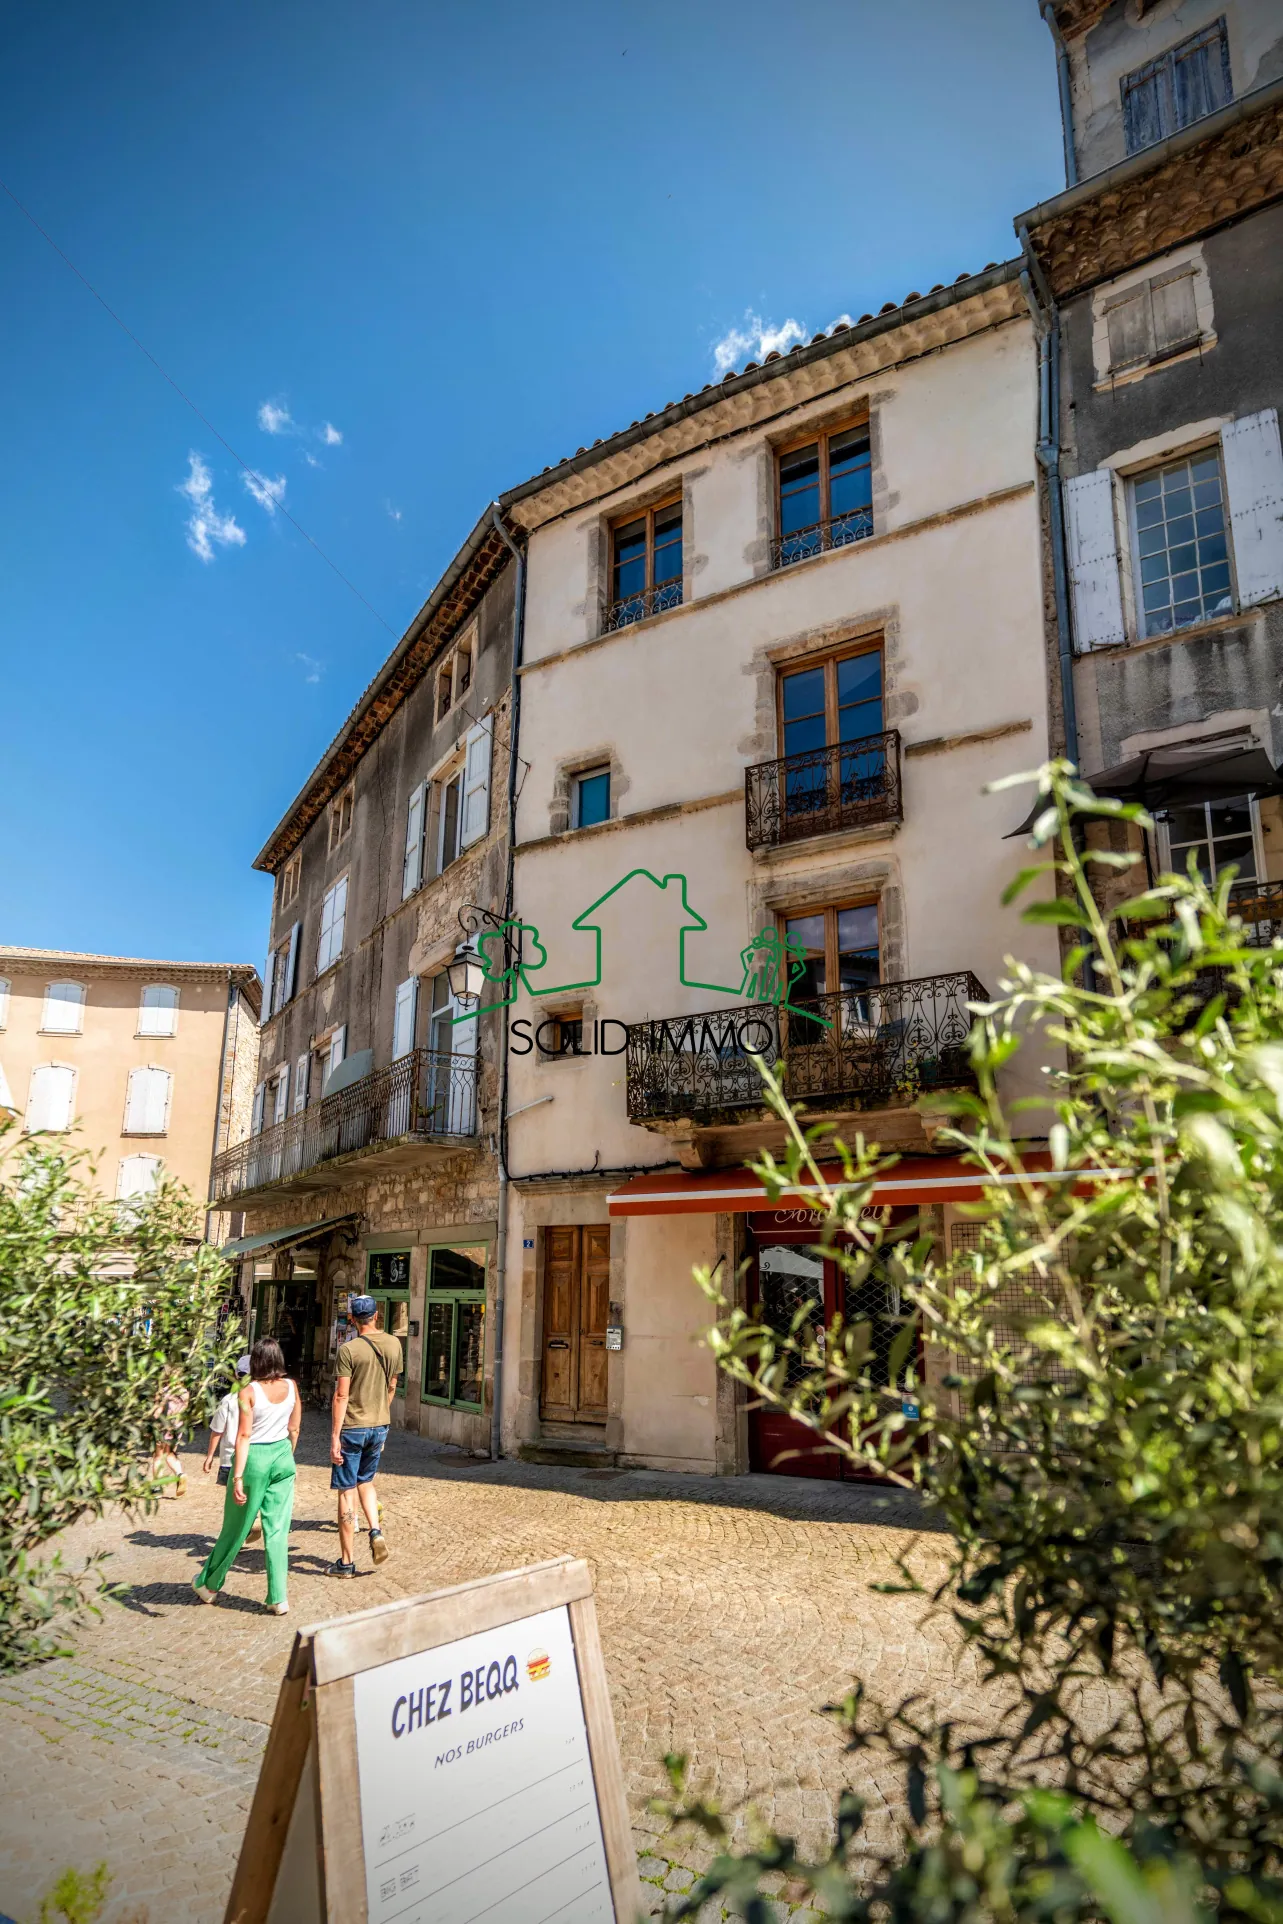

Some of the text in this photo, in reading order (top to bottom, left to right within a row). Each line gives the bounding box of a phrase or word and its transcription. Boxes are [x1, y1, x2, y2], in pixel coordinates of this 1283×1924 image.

[391, 1654, 520, 1739] CHEZ BEQQ
[434, 1717, 525, 1769] NOS BURGERS
